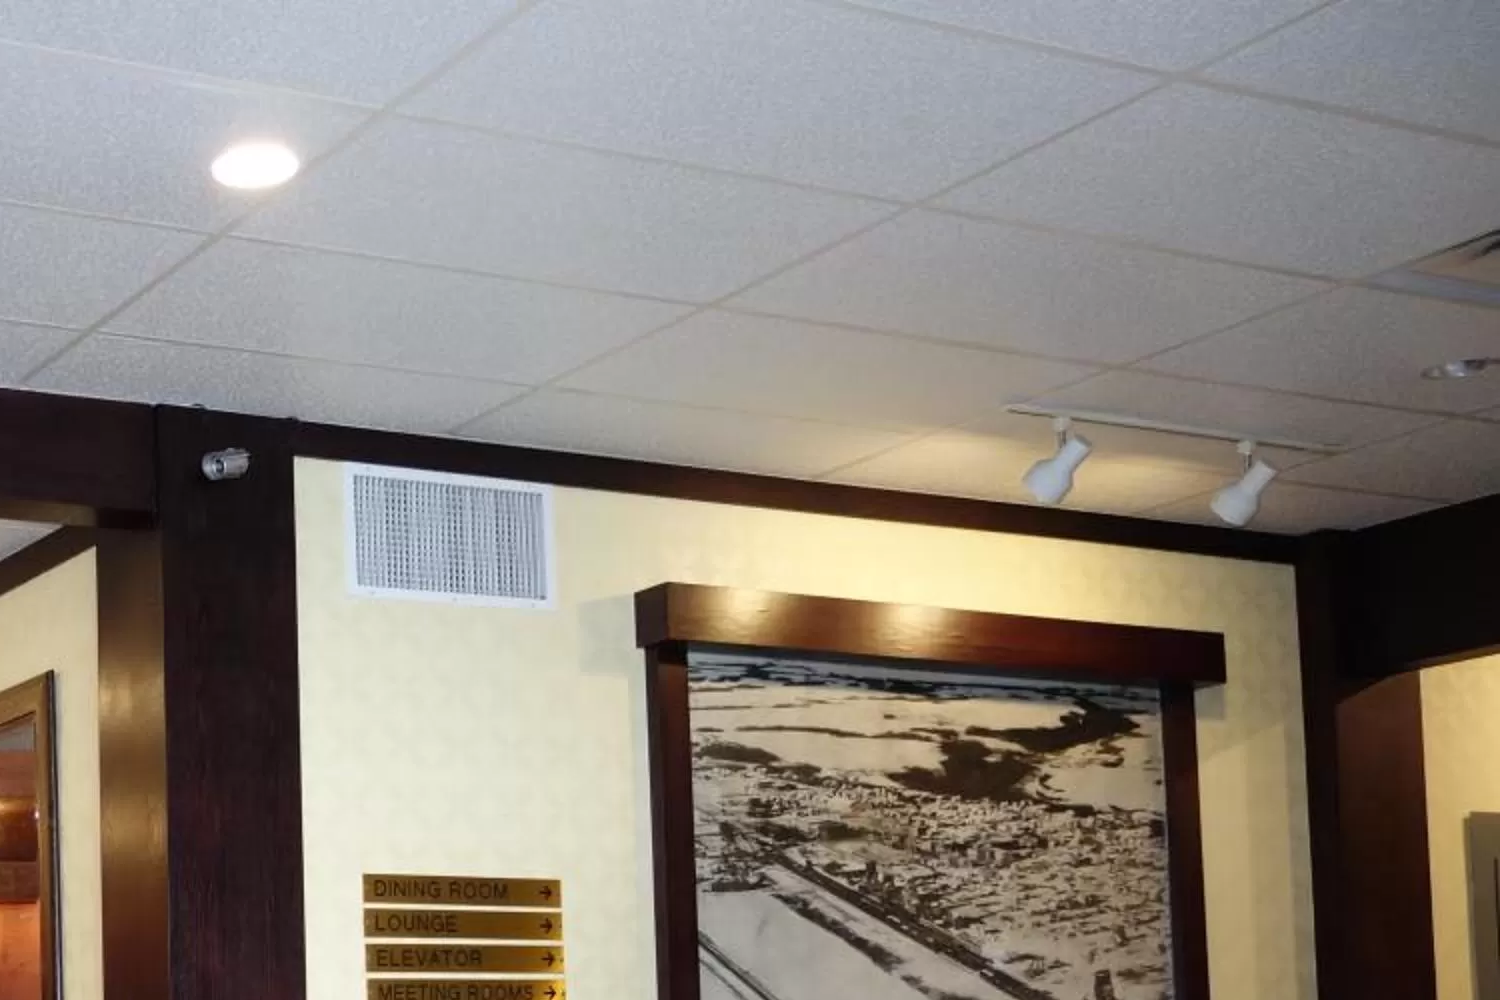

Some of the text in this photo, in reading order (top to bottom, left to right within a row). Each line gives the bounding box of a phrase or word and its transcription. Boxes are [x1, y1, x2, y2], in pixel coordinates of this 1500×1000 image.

[373, 879, 509, 899] DINING ROOM
[375, 913, 458, 932] LOUNGE
[376, 949, 483, 967] ELEVATOR
[378, 984, 534, 1000] MEETING ROOMS
